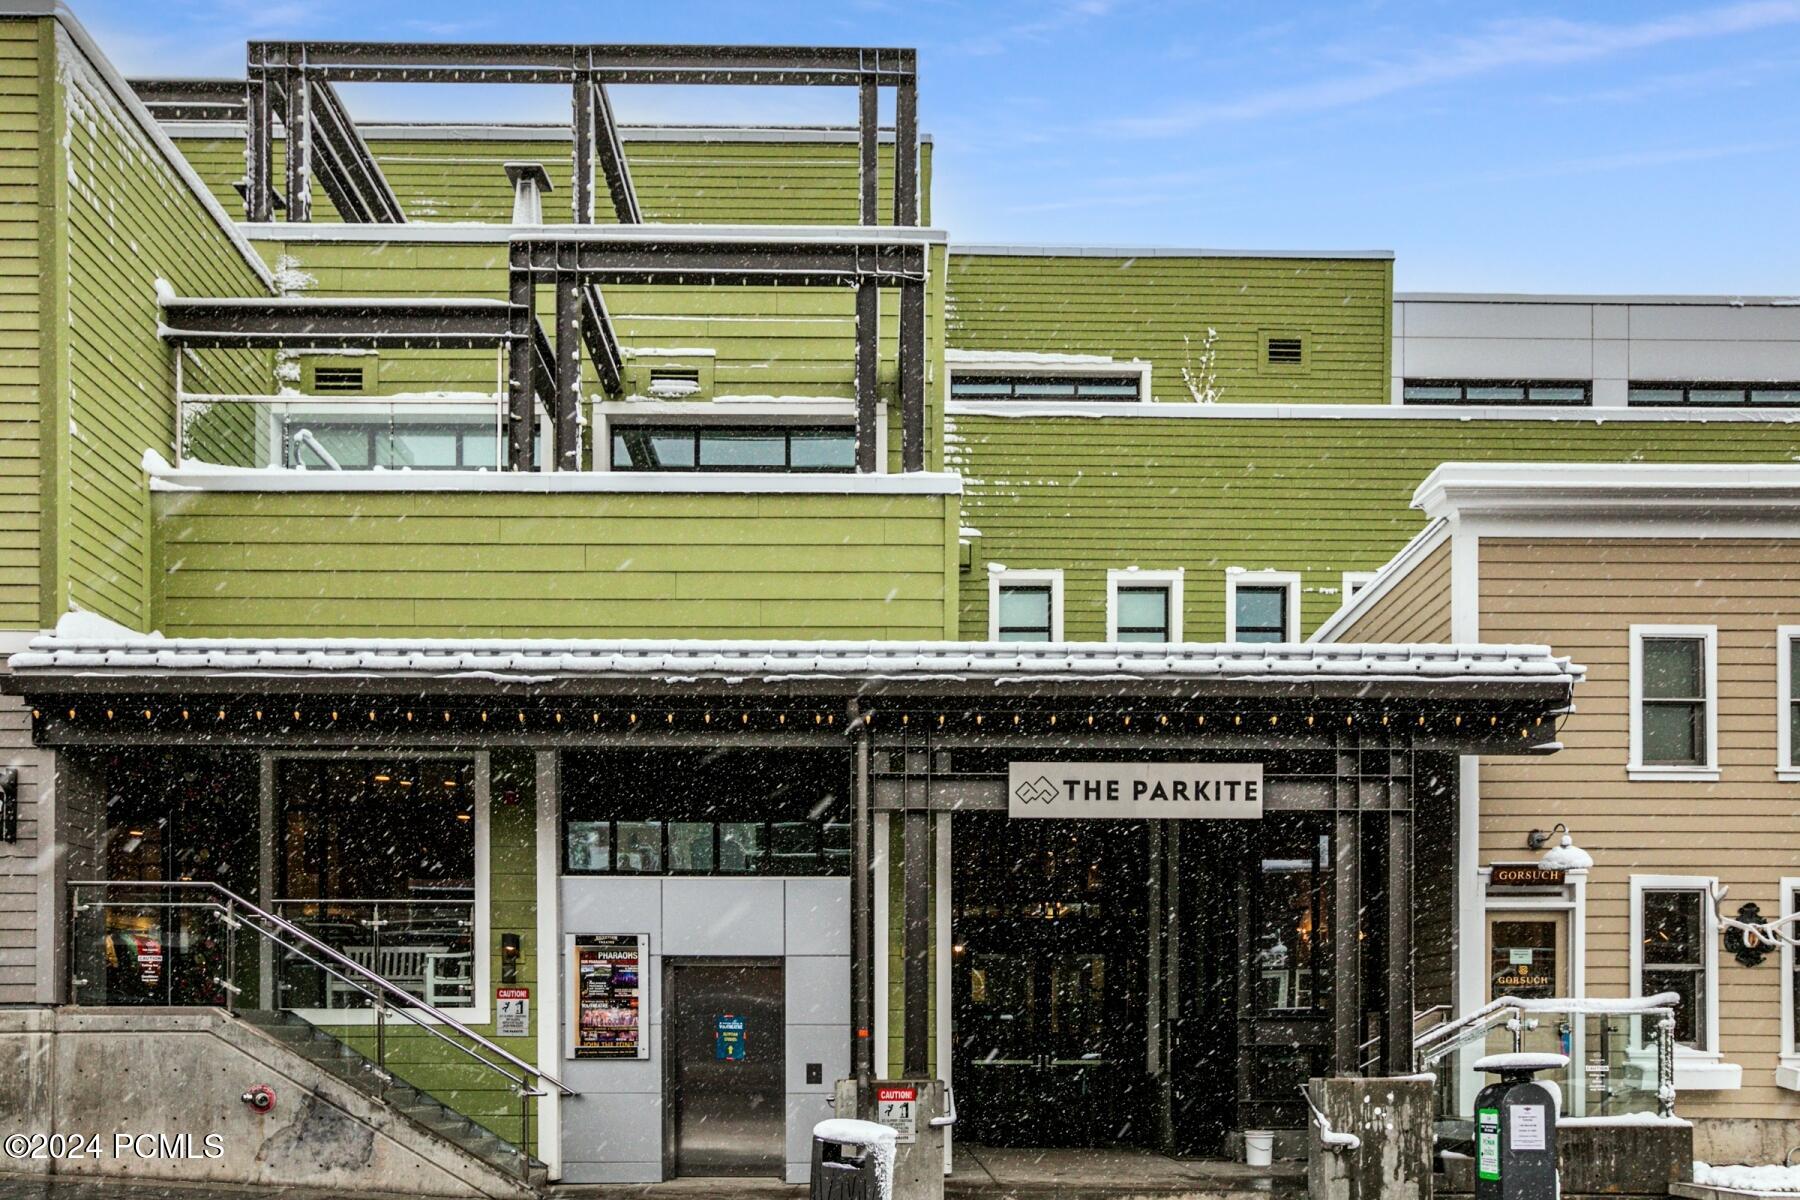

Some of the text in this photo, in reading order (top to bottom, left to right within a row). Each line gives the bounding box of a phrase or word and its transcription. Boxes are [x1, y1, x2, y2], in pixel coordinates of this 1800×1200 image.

[1063, 780, 1258, 801] THE PARKITE
[1499, 870, 1559, 880] GORSUCH
[598, 951, 638, 959] PHARAOHS
[1498, 976, 1548, 984] GORSUCH
[499, 990, 527, 998] CAUTION!
[881, 1091, 913, 1099] CAUTION!
